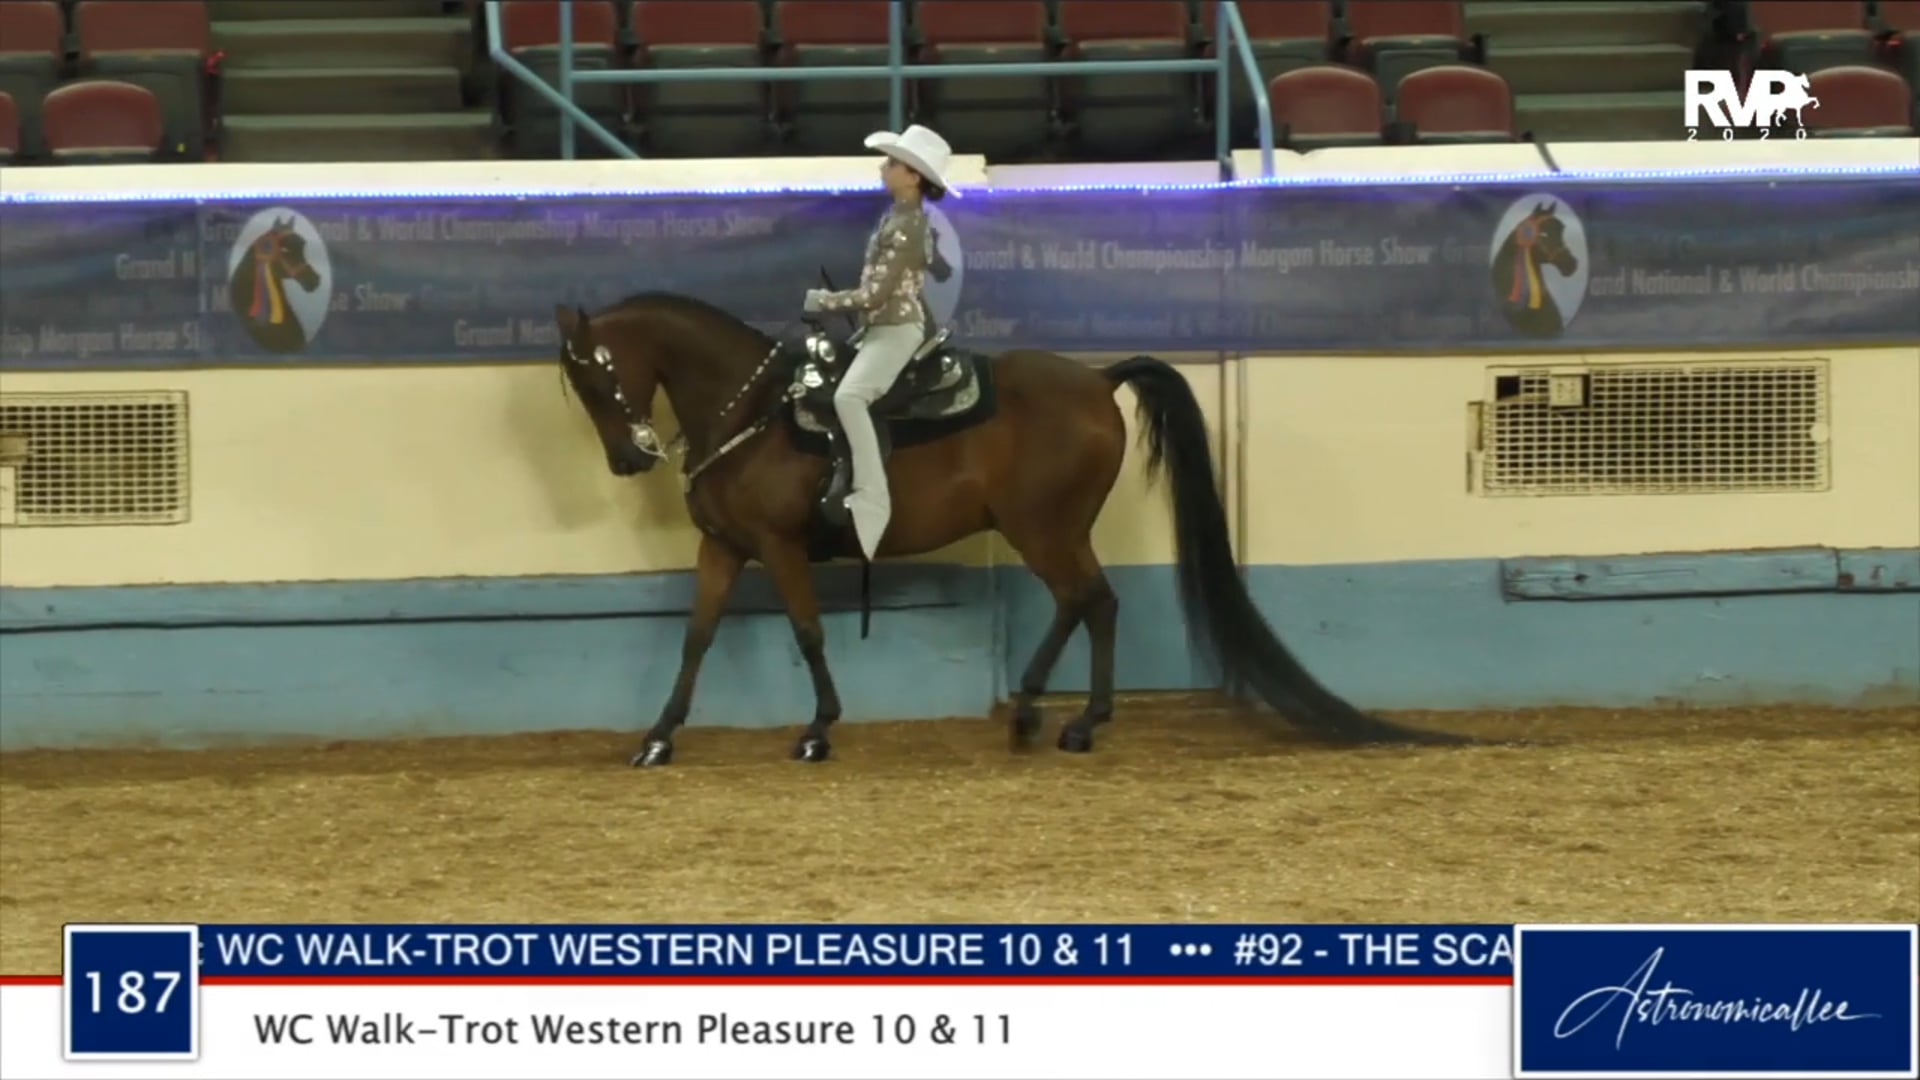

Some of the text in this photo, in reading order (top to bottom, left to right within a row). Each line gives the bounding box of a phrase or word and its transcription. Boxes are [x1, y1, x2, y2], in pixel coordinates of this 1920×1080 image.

[357, 215, 372, 241] &
[378, 210, 434, 241] World
[439, 208, 578, 245] Championship
[583, 210, 656, 246] Morgan
[663, 209, 719, 241] Horse
[723, 206, 776, 240] Show
[115, 250, 175, 280] Grand
[1021, 245, 1034, 270] &
[1040, 241, 1096, 270] World
[1101, 238, 1235, 276] Championship
[1240, 241, 1312, 274] Morgan
[1319, 239, 1374, 267] Horse
[1379, 236, 1433, 266] Show
[1632, 264, 1712, 295] National
[1719, 269, 1734, 293] &
[1739, 264, 1796, 292] World
[354, 282, 412, 312] Show
[38, 325, 114, 358] Morgan
[119, 322, 177, 351] Horse
[454, 317, 513, 347] Grand
